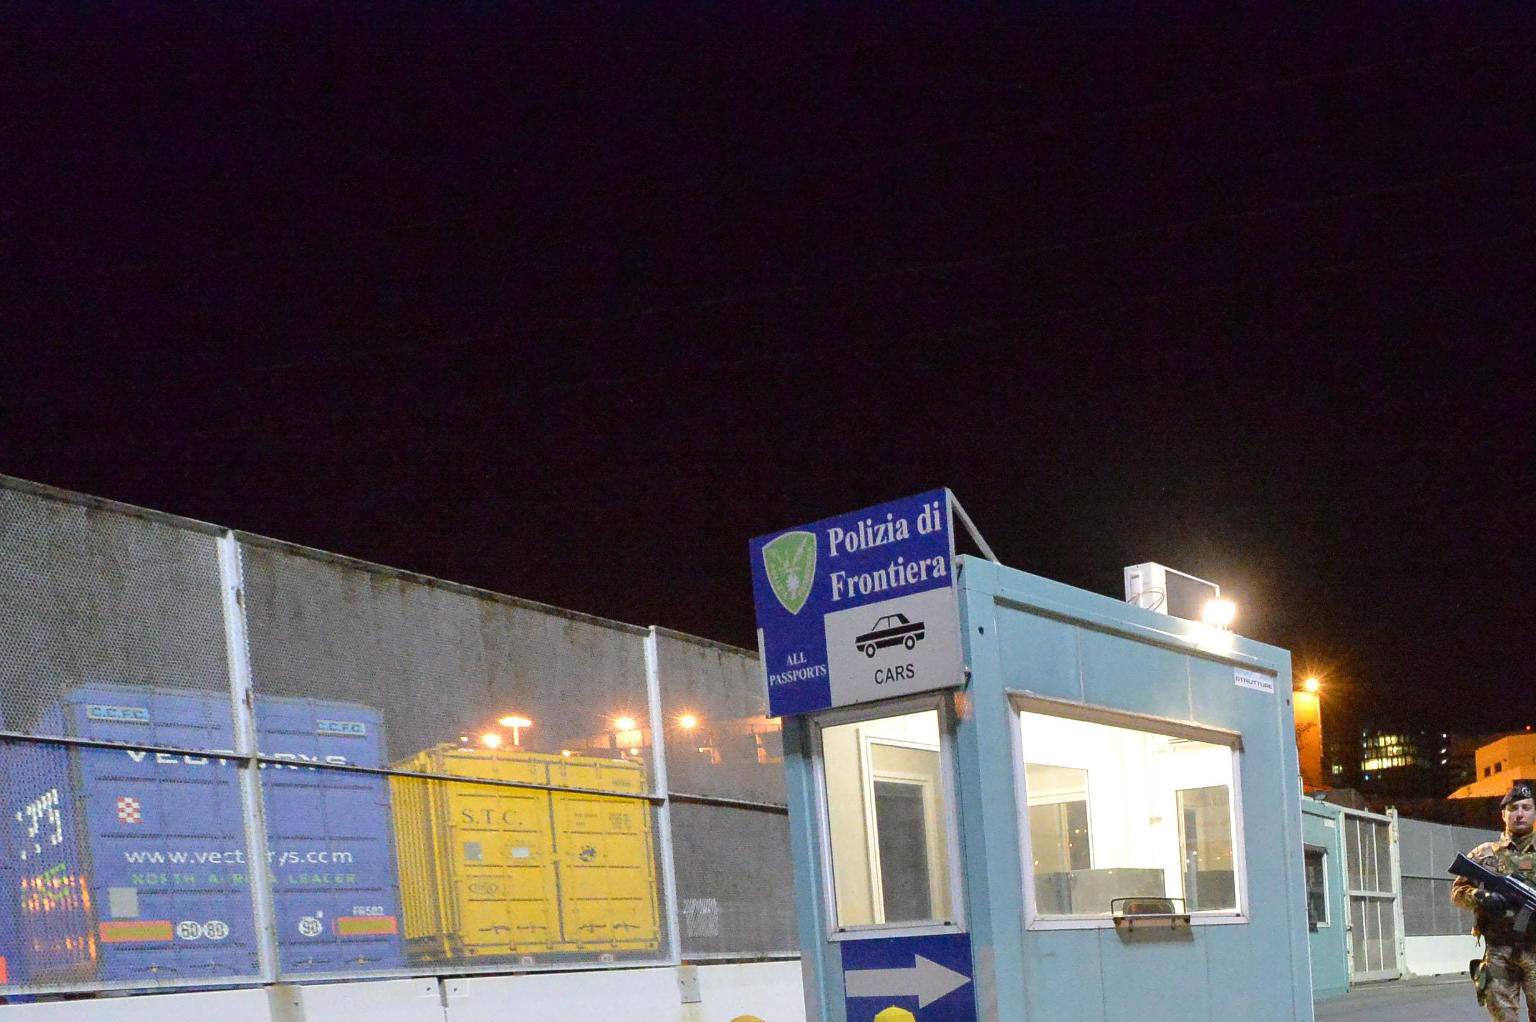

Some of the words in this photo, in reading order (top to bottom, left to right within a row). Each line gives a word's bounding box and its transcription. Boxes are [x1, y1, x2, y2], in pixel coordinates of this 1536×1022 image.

[827, 511, 910, 558] Polizia
[916, 500, 942, 535] di
[829, 555, 947, 602] Frontiera
[786, 651, 807, 667] ALL
[768, 664, 827, 687] PASSPORTS
[874, 663, 915, 685] CARS
[462, 807, 523, 826] S.T.C.
[125, 850, 353, 867] www.vectrys.com
